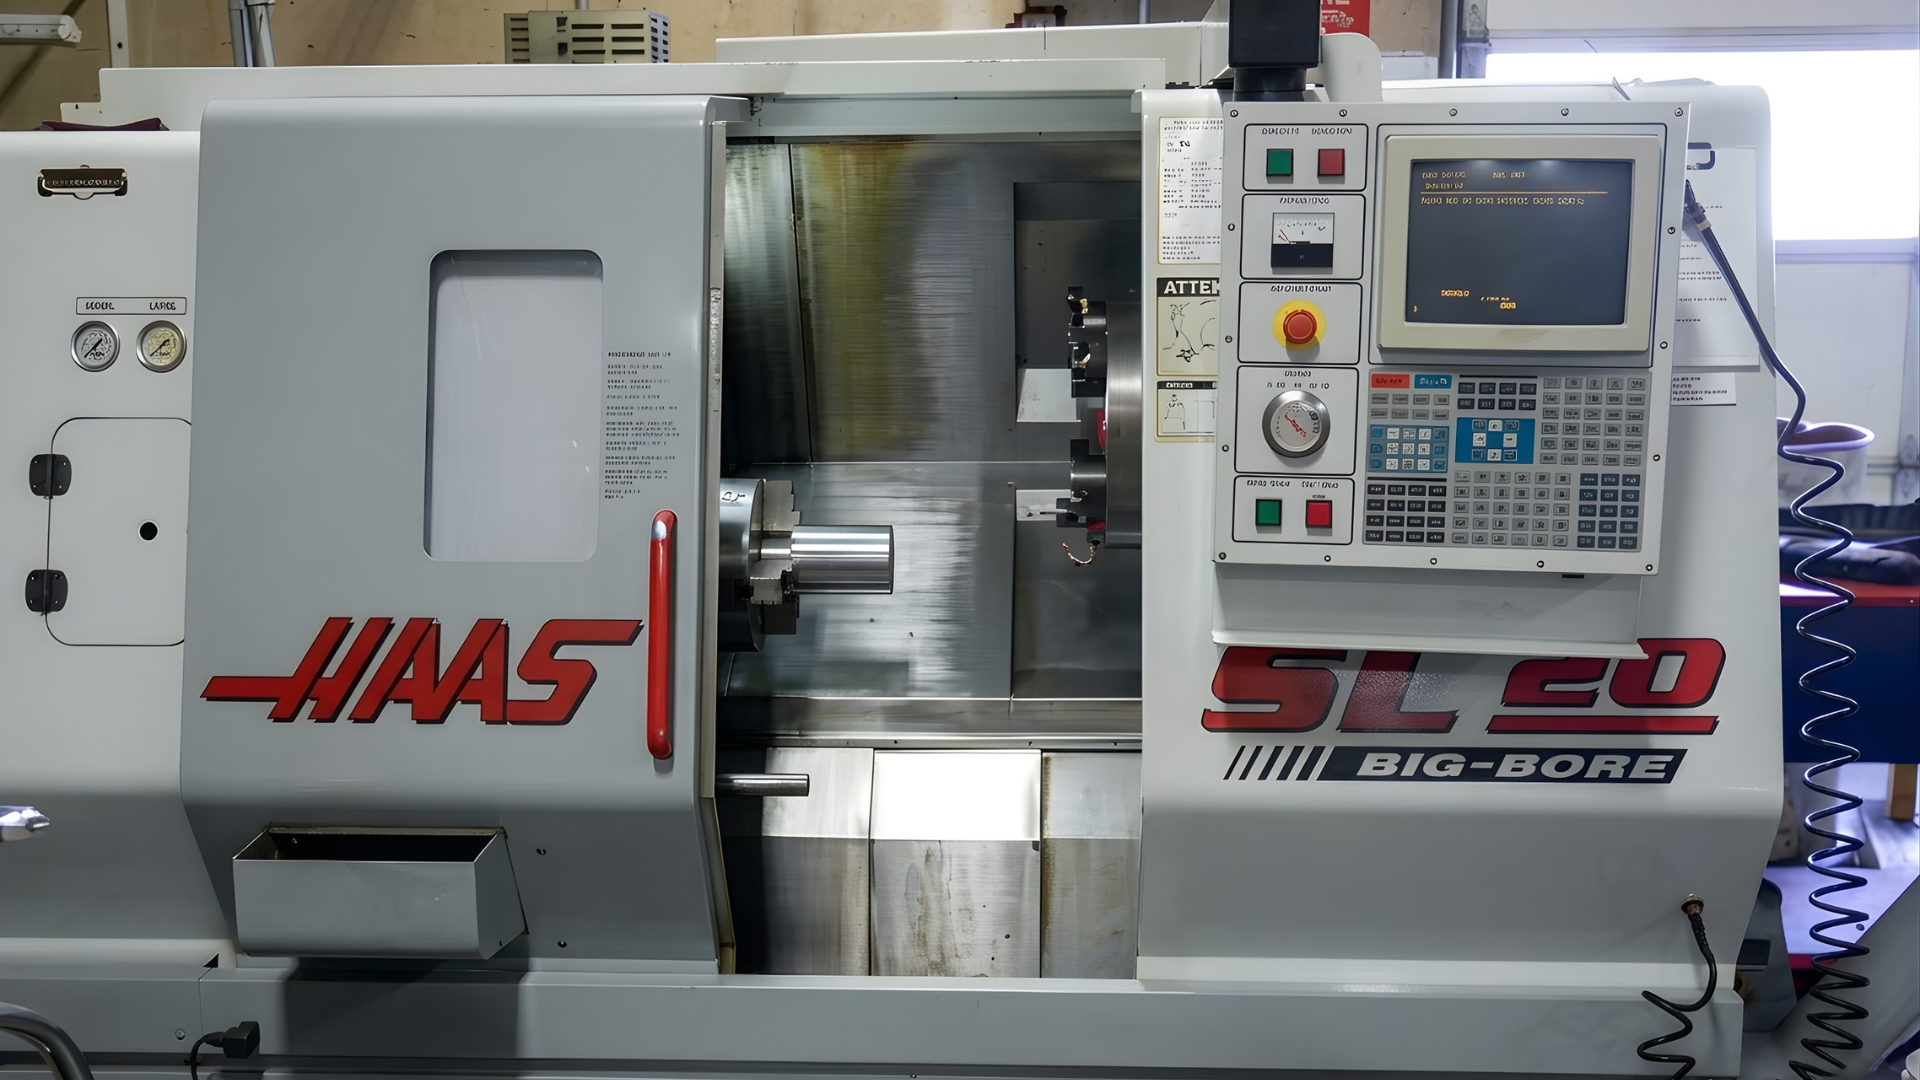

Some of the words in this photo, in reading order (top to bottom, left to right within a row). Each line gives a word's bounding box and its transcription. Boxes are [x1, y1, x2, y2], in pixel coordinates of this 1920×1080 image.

[200, 617, 644, 725] HAAS
[1201, 645, 1459, 733] SL
[1501, 638, 1726, 708] 20
[1356, 753, 1674, 779] BIG-BORE
